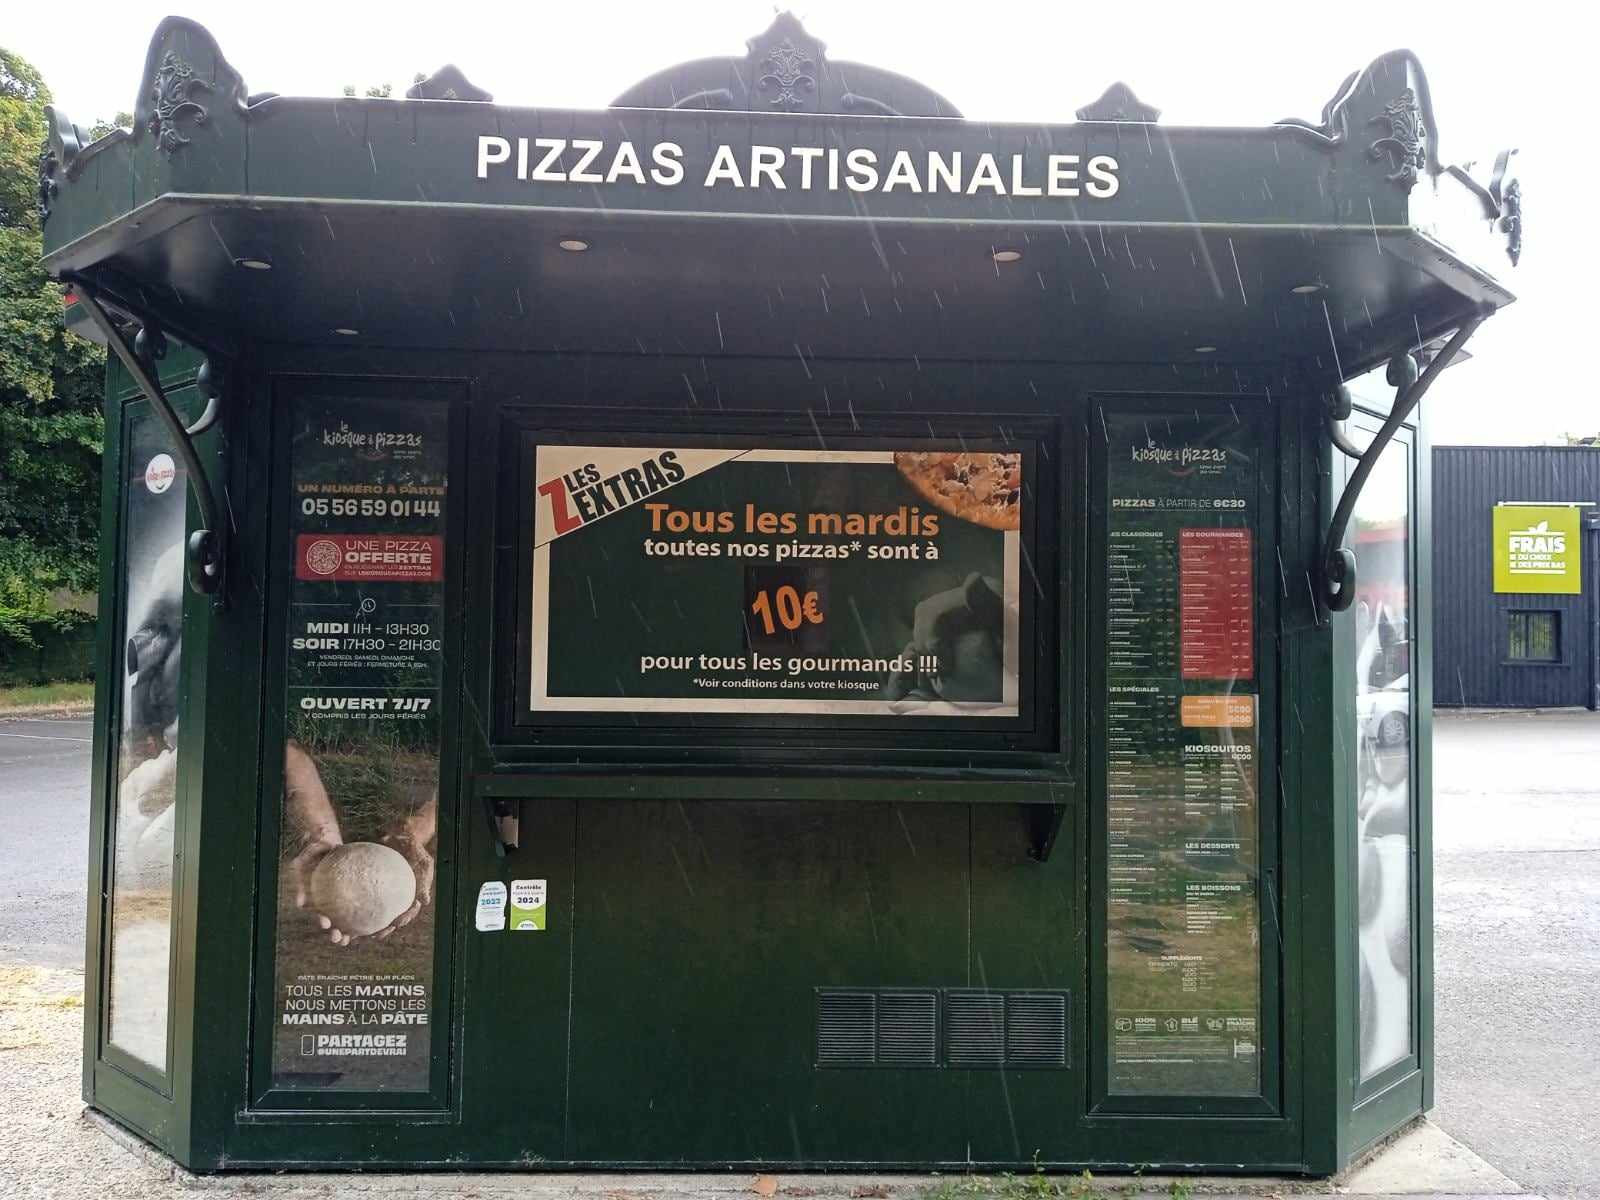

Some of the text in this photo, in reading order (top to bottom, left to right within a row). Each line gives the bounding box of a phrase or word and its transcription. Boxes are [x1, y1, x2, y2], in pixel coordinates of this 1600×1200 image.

[477, 135, 1120, 199] PIZZAS ARTISANALES
[323, 428, 366, 448] kiosque
[375, 432, 423, 450] pizzas
[1132, 445, 1172, 464] kiosque
[1182, 447, 1227, 466] pizzas
[562, 463, 601, 493] LES
[301, 498, 441, 517] 05 56 59 01 44
[1112, 499, 1155, 508] PIZZAS
[1166, 499, 1197, 508] PARTIR
[644, 503, 940, 537] Tous les mardis
[345, 540, 432, 551] UNE PIZZA
[643, 538, 721, 557] toutes
[727, 543, 769, 557] nos
[867, 543, 919, 560] sont
[925, 541, 939, 560] à
[1509, 535, 1566, 553] FRAIS
[345, 552, 432, 564] OFFERTE
[752, 585, 824, 635] 10€
[306, 623, 348, 634] MIDI
[352, 624, 371, 635] 11H
[386, 624, 429, 635] 13H30
[292, 638, 340, 650] SOIR
[343, 639, 385, 650] 17H30
[399, 639, 441, 651] 21H30
[640, 652, 938, 675] pour tous les gourmands !!!
[722, 678, 778, 689] conditions
[779, 679, 806, 689] dans
[807, 680, 835, 690] votre
[838, 680, 880, 691] kiosque
[300, 698, 388, 710] OUVERT
[1184, 744, 1252, 753] KIOSQUITOS
[517, 896, 540, 904] 2024
[286, 985, 425, 997] TOUS LES MATINS
[285, 999, 426, 1011] NOUS METTONS LES
[282, 1011, 428, 1025] MAINS À LA PÂTE
[317, 1034, 407, 1048] PARTAGEZ
